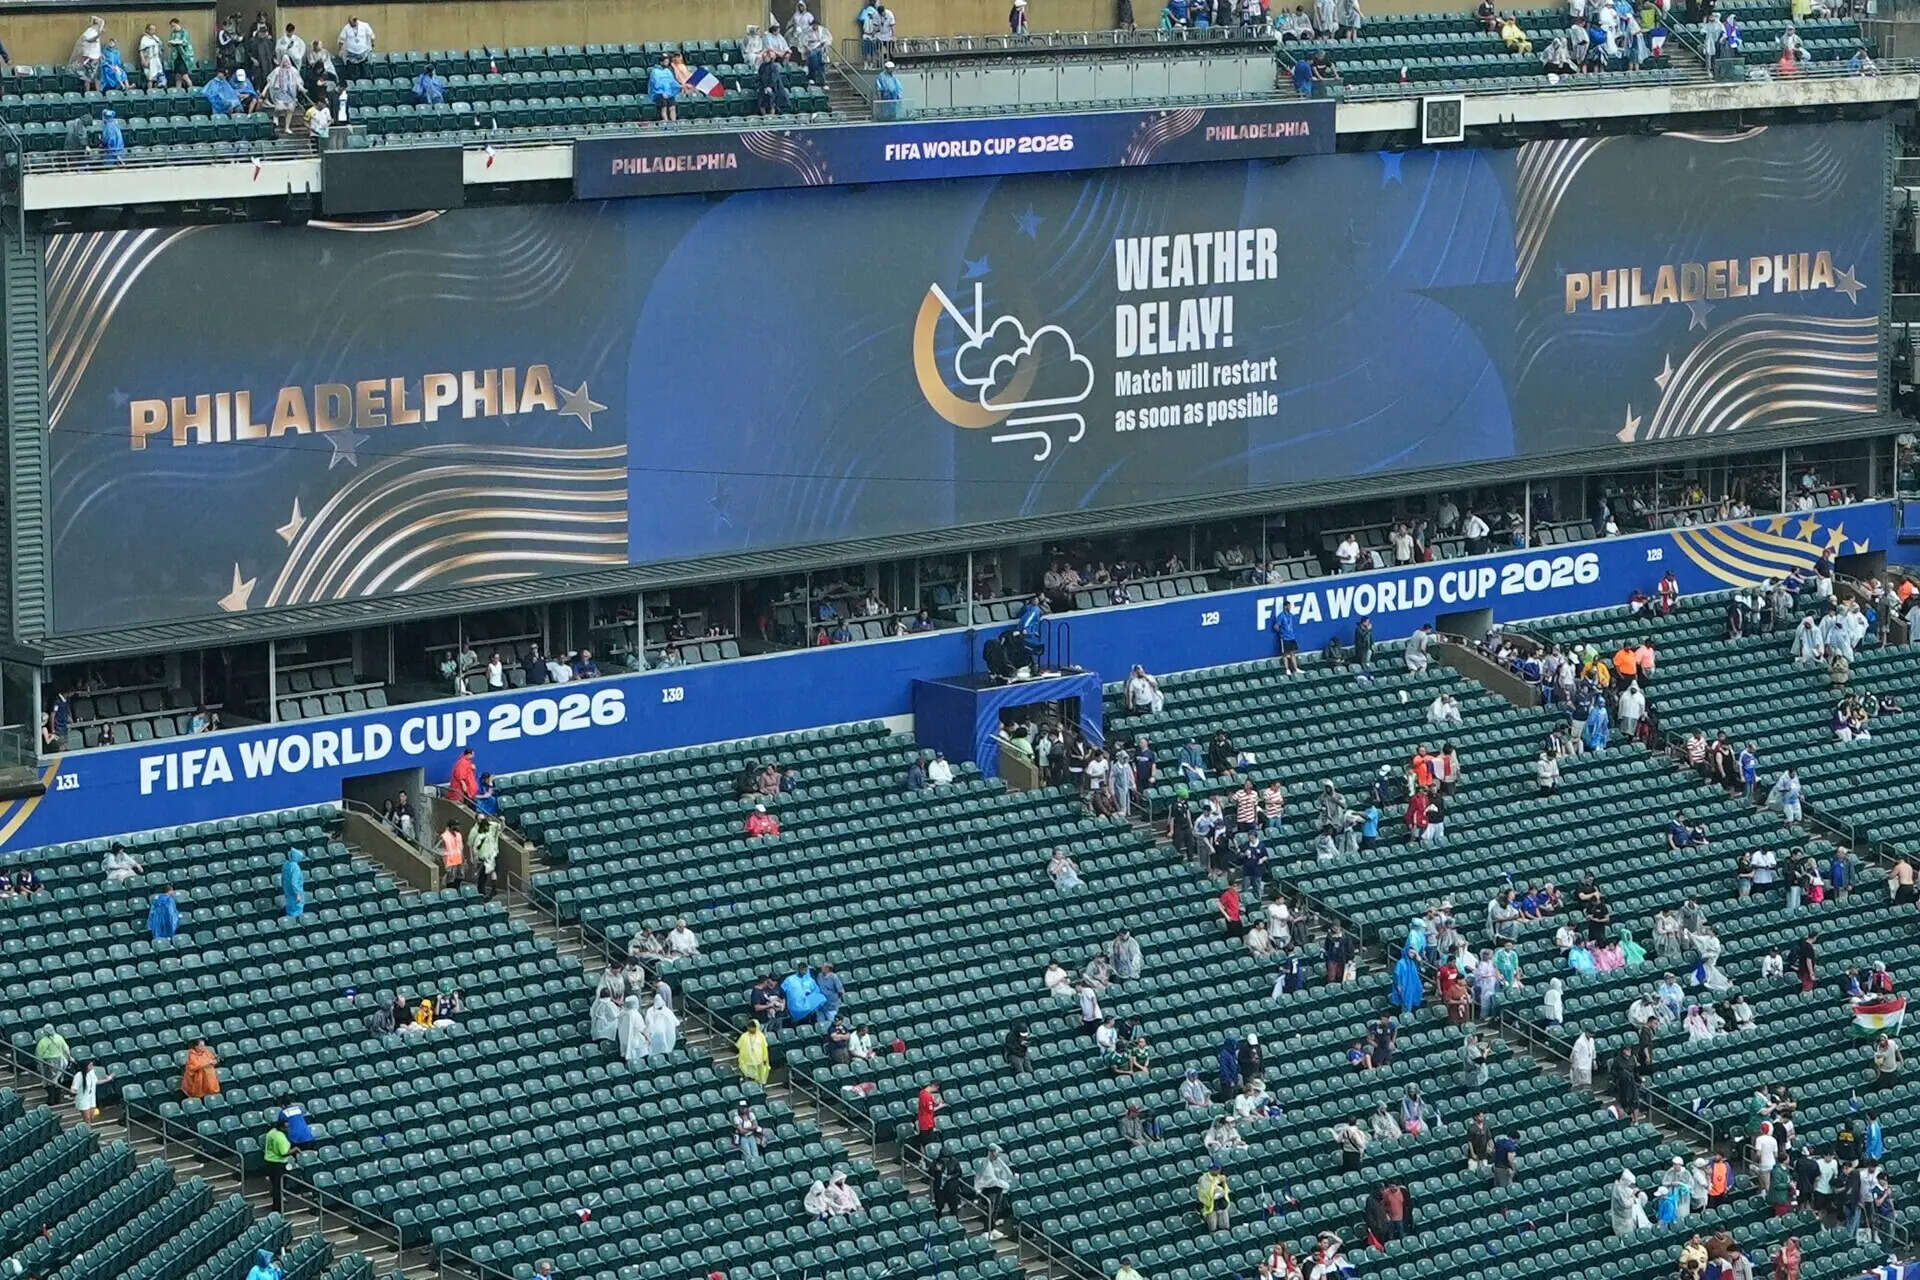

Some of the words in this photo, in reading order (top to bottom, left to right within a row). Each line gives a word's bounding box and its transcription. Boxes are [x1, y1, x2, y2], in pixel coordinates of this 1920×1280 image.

[885, 143, 921, 161] FIFA
[923, 140, 981, 158] WORLD
[984, 138, 1016, 155] CUP
[1018, 134, 1073, 153] 2026
[1206, 121, 1309, 141] PHILADELPHIA
[612, 153, 737, 175] PHILADELPHIA
[1115, 228, 1278, 292] WEATHER
[1566, 251, 1835, 314] PHILADELPHIA
[1116, 296, 1233, 358] DELAY!
[1115, 366, 1173, 397] Match
[1177, 362, 1209, 390] will
[1213, 357, 1278, 387] restart
[130, 364, 558, 451] PHILADELPHIA
[1115, 408, 1136, 432] as
[1139, 404, 1180, 430] soon
[1184, 402, 1204, 425] as
[1207, 390, 1278, 427] possible
[1326, 574, 1434, 620] WORLD
[1439, 567, 1497, 604] CUP
[1501, 552, 1600, 596] 2026
[1201, 611, 1220, 626] 129
[662, 687, 684, 703] 130
[140, 746, 234, 796] FIFA
[239, 722, 393, 779] WORLD
[400, 710, 481, 755] CUP
[488, 688, 626, 742] 2026
[56, 773, 80, 790] 131
